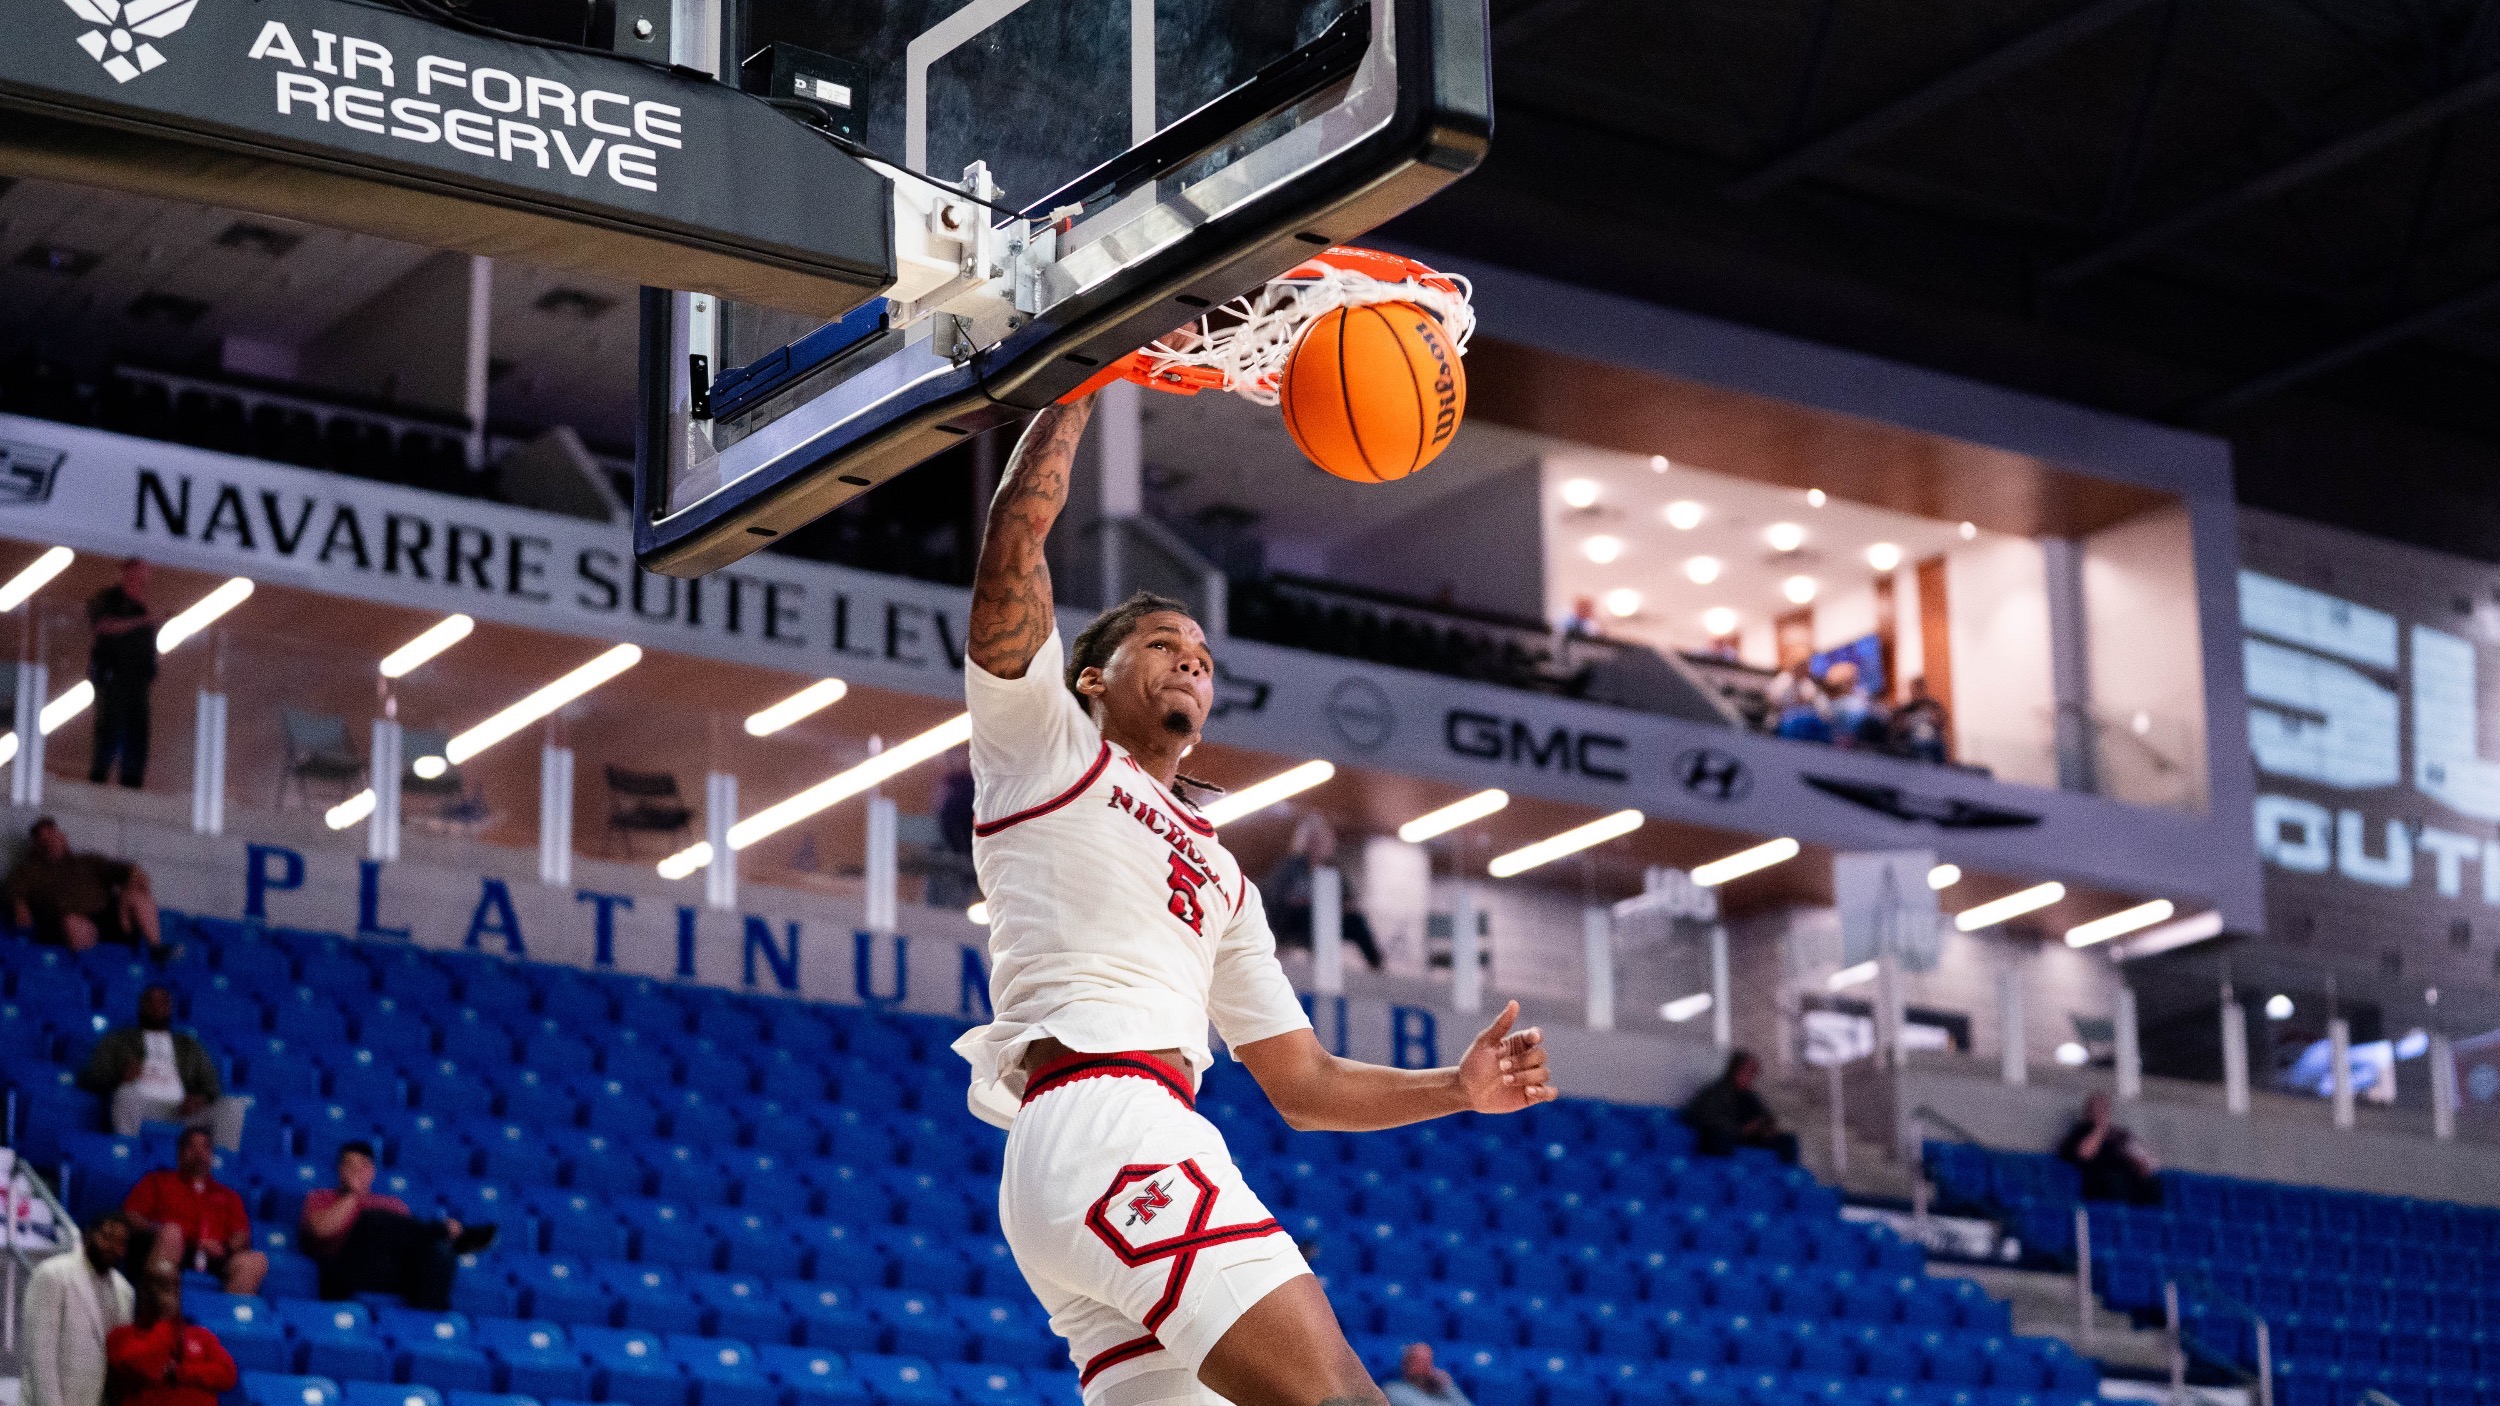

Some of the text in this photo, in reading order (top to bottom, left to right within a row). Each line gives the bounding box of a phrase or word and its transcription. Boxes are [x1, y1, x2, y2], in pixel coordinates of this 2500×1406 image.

[248, 20, 682, 149] AIR FORCE
[277, 71, 658, 192] RESERVE
[1415, 321, 1456, 447] Wilson
[134, 467, 552, 600] NAVARRE
[575, 546, 805, 647] SUITE
[833, 591, 969, 673] LEV
[1445, 708, 1630, 783] GMC
[1167, 850, 1208, 937] 5
